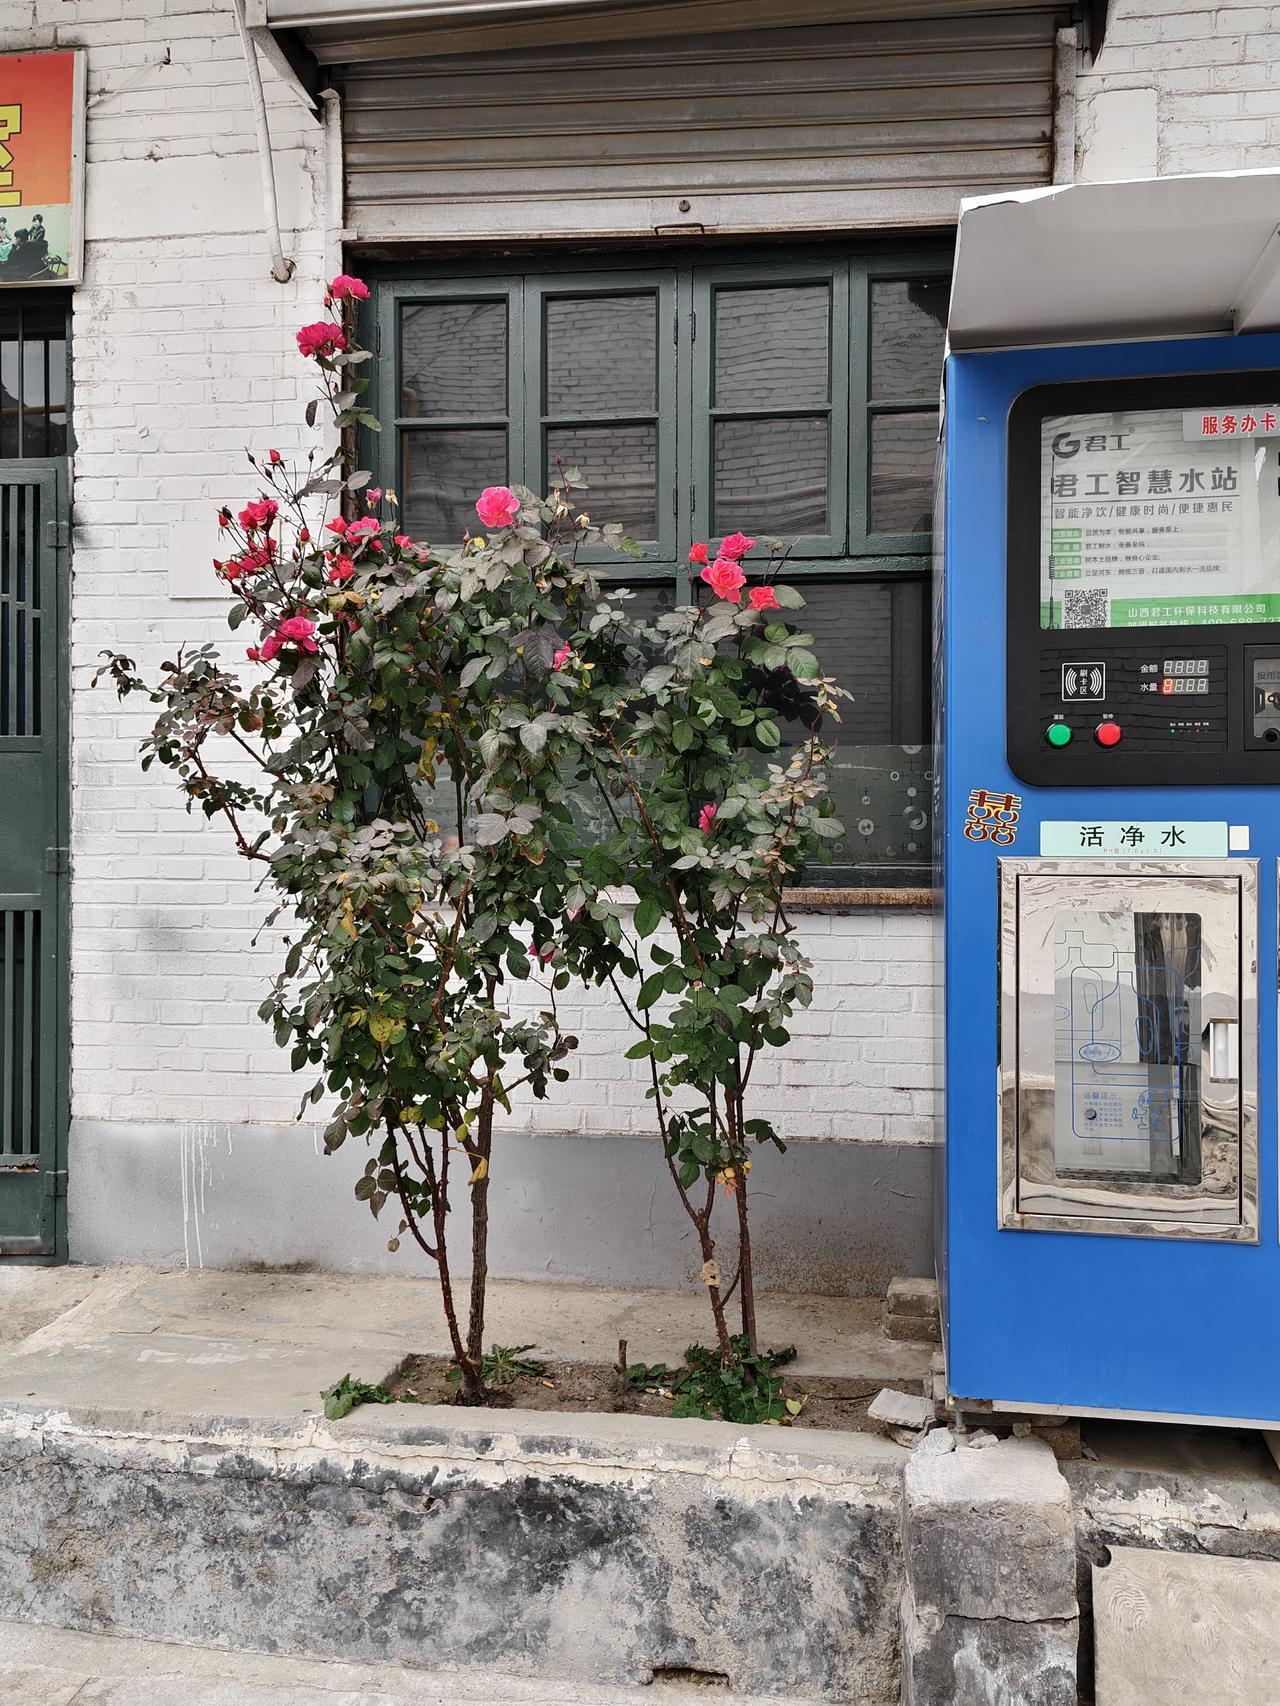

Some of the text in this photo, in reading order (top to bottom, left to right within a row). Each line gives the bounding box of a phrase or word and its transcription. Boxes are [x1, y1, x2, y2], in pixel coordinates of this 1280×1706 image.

[1201, 412, 1278, 435] 服务办卡
[1084, 434, 1131, 452] 君工
[1053, 466, 1238, 498] 君工智慧水站
[1054, 500, 1233, 519] 智能净饮/健康时尚/便捷惠民
[1128, 603, 1266, 618] 山西君工环保科技有限公司
[1140, 664, 1158, 674] 金额
[1079, 668, 1088, 695] 刷卡区
[1140, 682, 1158, 692] 水量
[1079, 825, 1186, 847] 活净水
